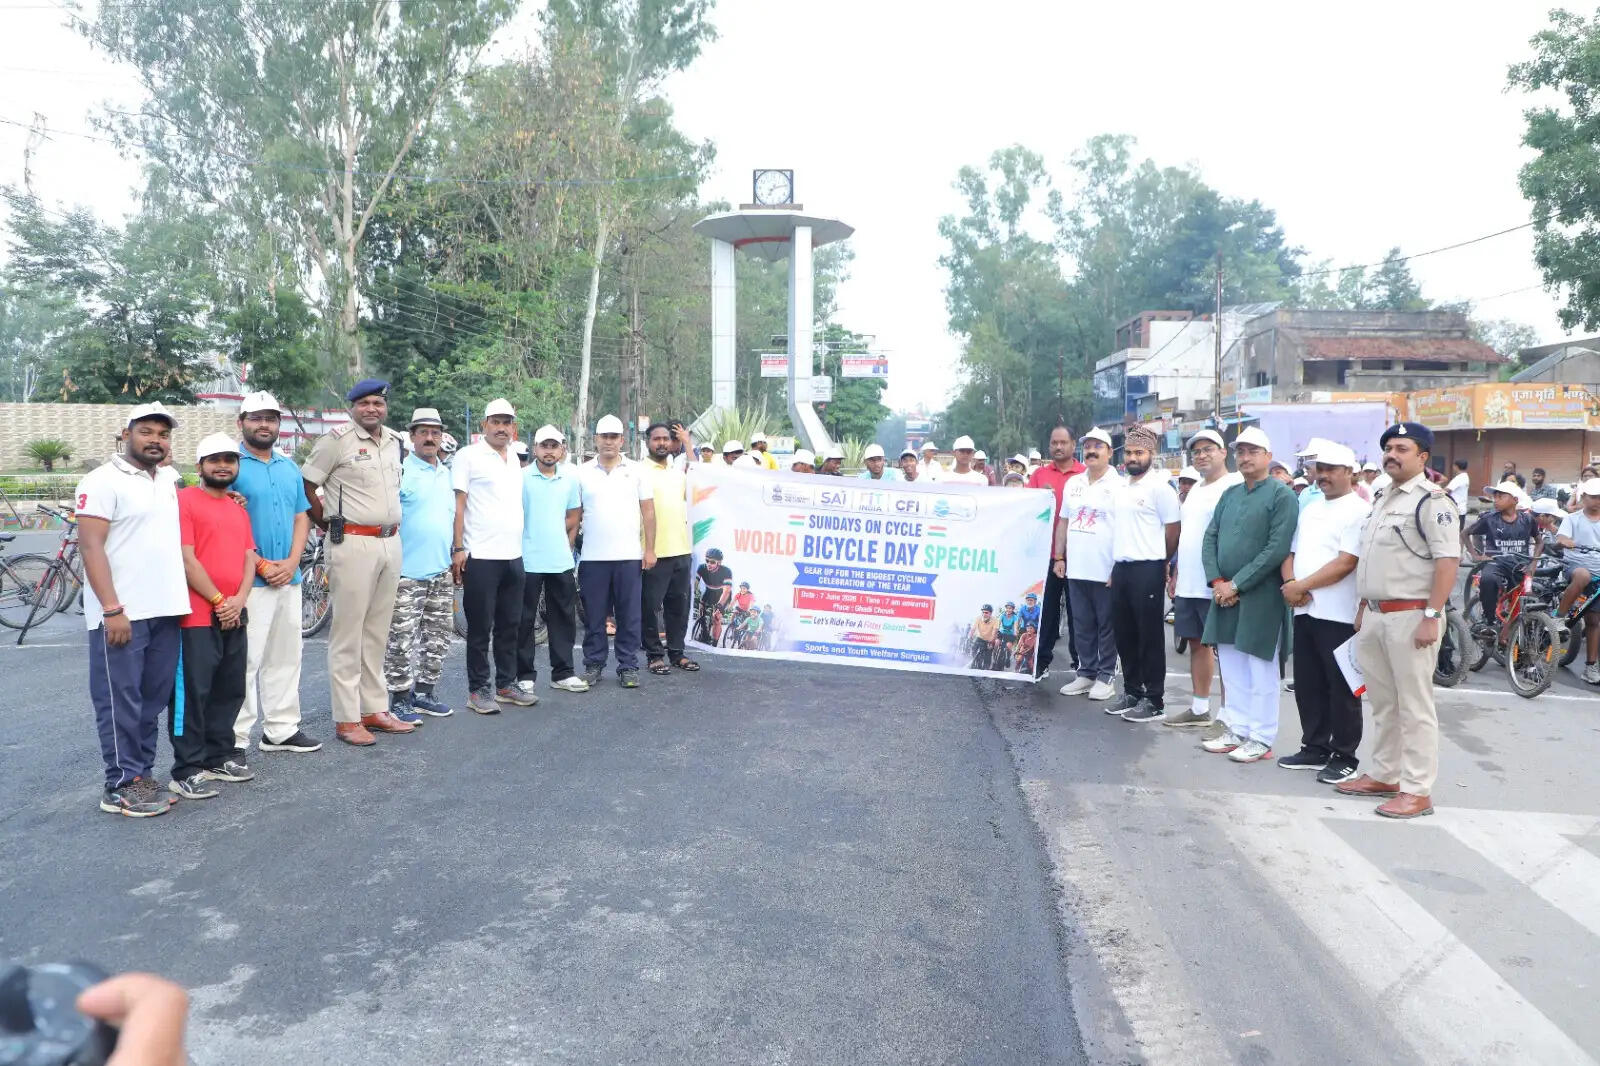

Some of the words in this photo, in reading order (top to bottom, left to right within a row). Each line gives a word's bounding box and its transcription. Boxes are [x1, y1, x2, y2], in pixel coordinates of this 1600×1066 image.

[1511, 387, 1533, 403] पूजा
[77, 493, 88, 510] 3
[895, 498, 920, 513] CFI
[808, 513, 862, 533] SUNDAYS
[865, 519, 881, 534] ON
[885, 521, 923, 538] CYCLE
[733, 528, 797, 556] WORLD
[803, 534, 878, 563] BICYCLE
[884, 541, 919, 566] DAY
[923, 543, 999, 574] SPECIAL
[804, 566, 823, 575] GEAR
[824, 568, 835, 576] UP
[836, 569, 849, 577] FOR
[851, 570, 865, 578] THE
[866, 571, 896, 582] BIGGEST
[897, 574, 927, 584] CYCLING
[818, 576, 865, 588] CELEBRATION
[867, 580, 876, 589] OF
[878, 582, 891, 590] THE
[893, 583, 911, 592] YEAR
[813, 616, 829, 625] Let's
[830, 617, 845, 627] Ride
[846, 619, 857, 628] For
[857, 620, 863, 629] A
[805, 643, 829, 654] Sports
[831, 646, 846, 654] and
[847, 647, 869, 656] Youth
[870, 648, 899, 658] Welfare
